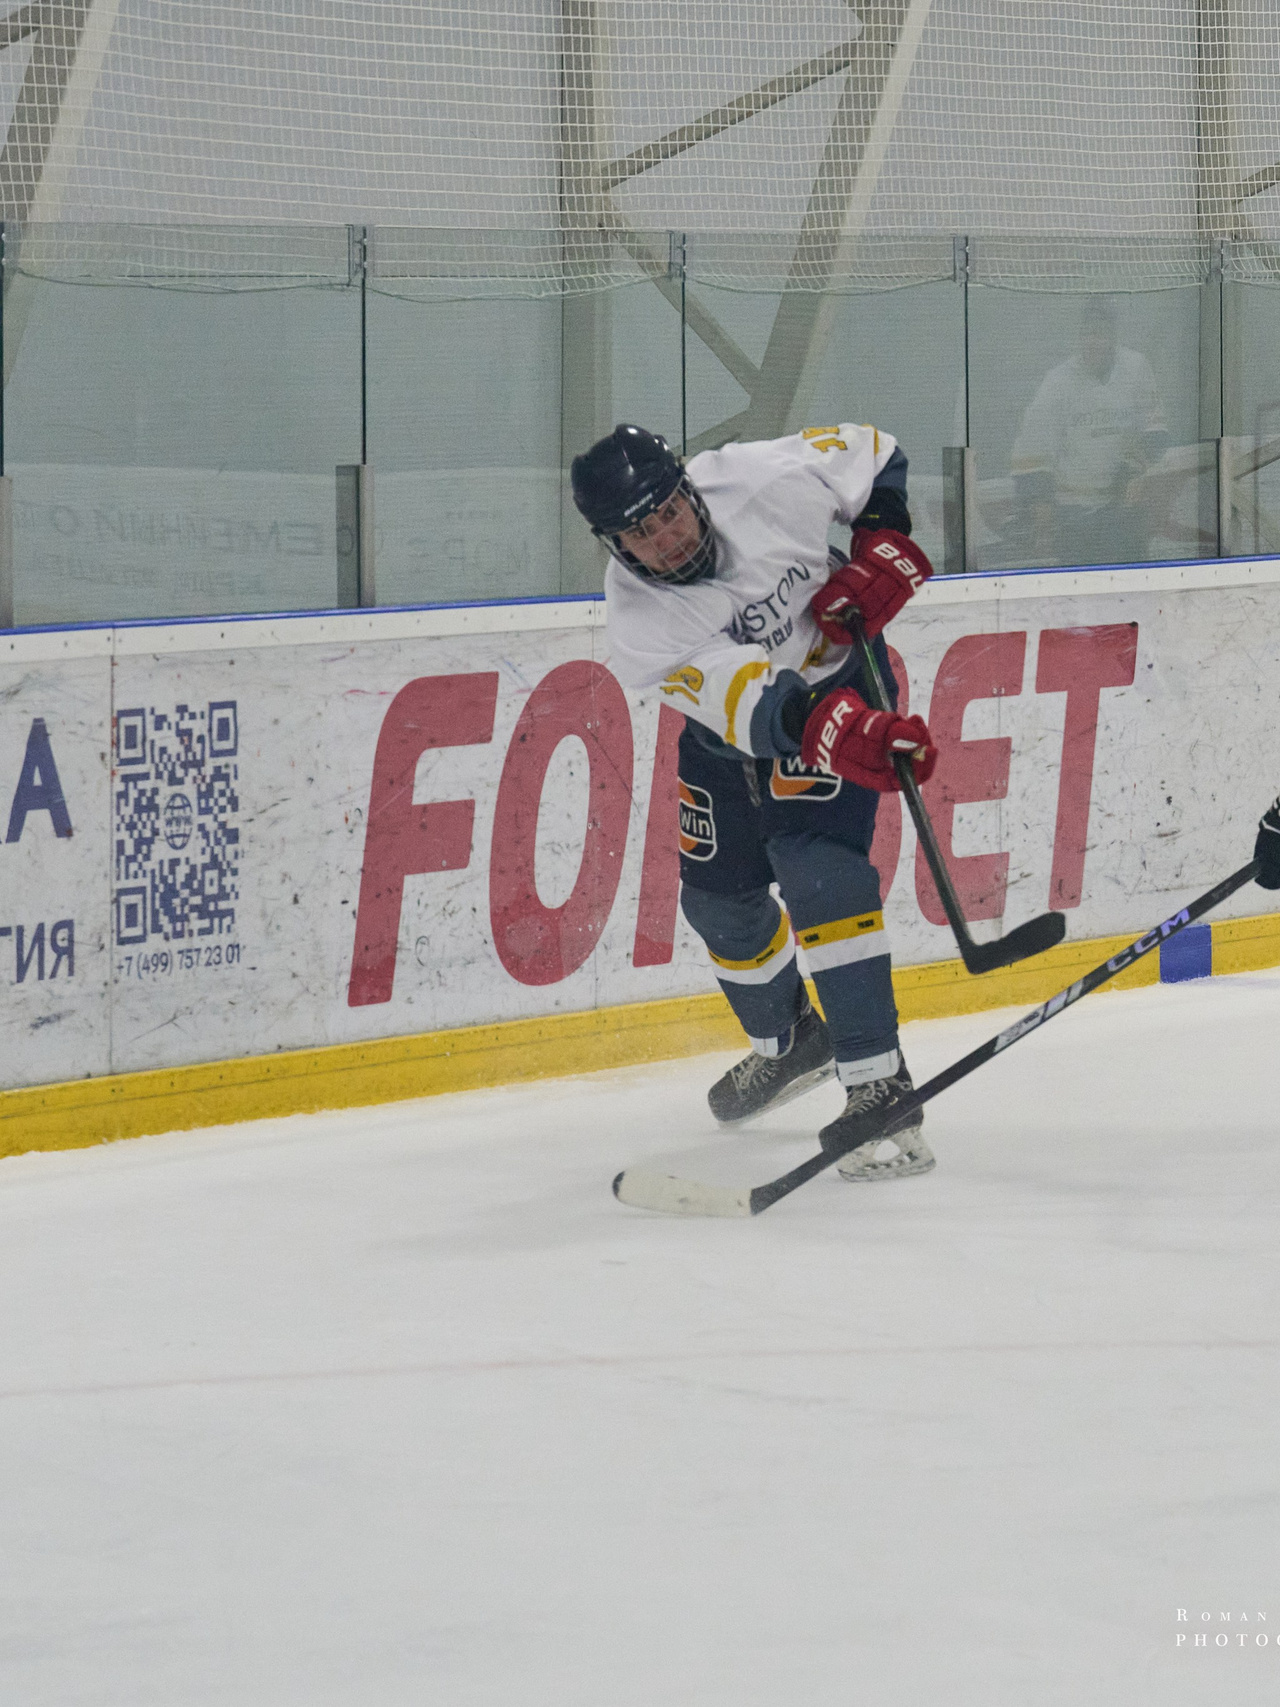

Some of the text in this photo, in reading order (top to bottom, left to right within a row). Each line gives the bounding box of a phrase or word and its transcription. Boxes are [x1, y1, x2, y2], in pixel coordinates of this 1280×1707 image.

[347, 622, 1139, 1007] FOET
[116, 943, 241, 980] +7 (499) 757 23 01
[1106, 907, 1191, 972] CCM
